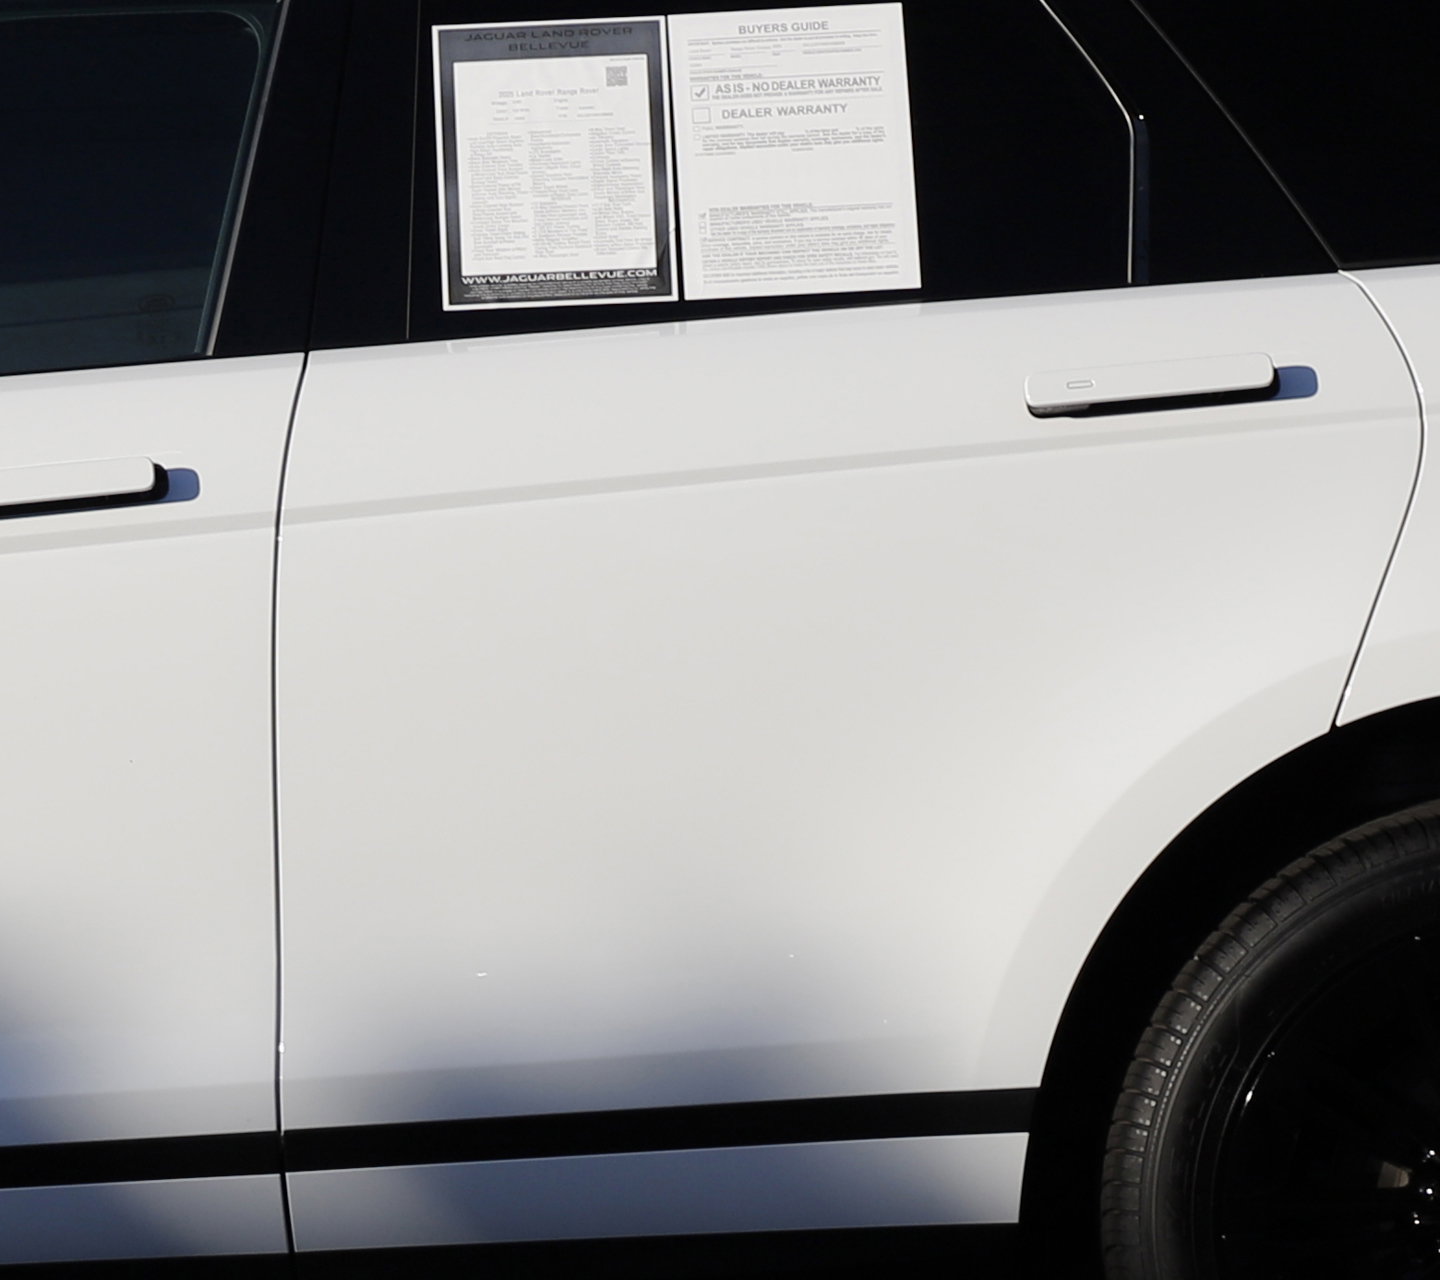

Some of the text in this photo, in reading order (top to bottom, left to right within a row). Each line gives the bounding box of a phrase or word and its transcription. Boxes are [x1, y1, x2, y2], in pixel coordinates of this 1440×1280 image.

[464, 26, 633, 42] JAGUAR LAND ROVER
[738, 20, 829, 35] BUYERS GUIDE
[508, 40, 590, 52] BELLEVUE
[715, 83, 732, 94] AS
[733, 82, 744, 93] IS
[752, 81, 770, 92] NO
[771, 79, 816, 91] DEALER
[817, 76, 881, 89] WARRANTY
[721, 103, 848, 120] DEALER WARRANTY
[461, 268, 657, 285] WWW.JAGUARBELLEVUE.COM
